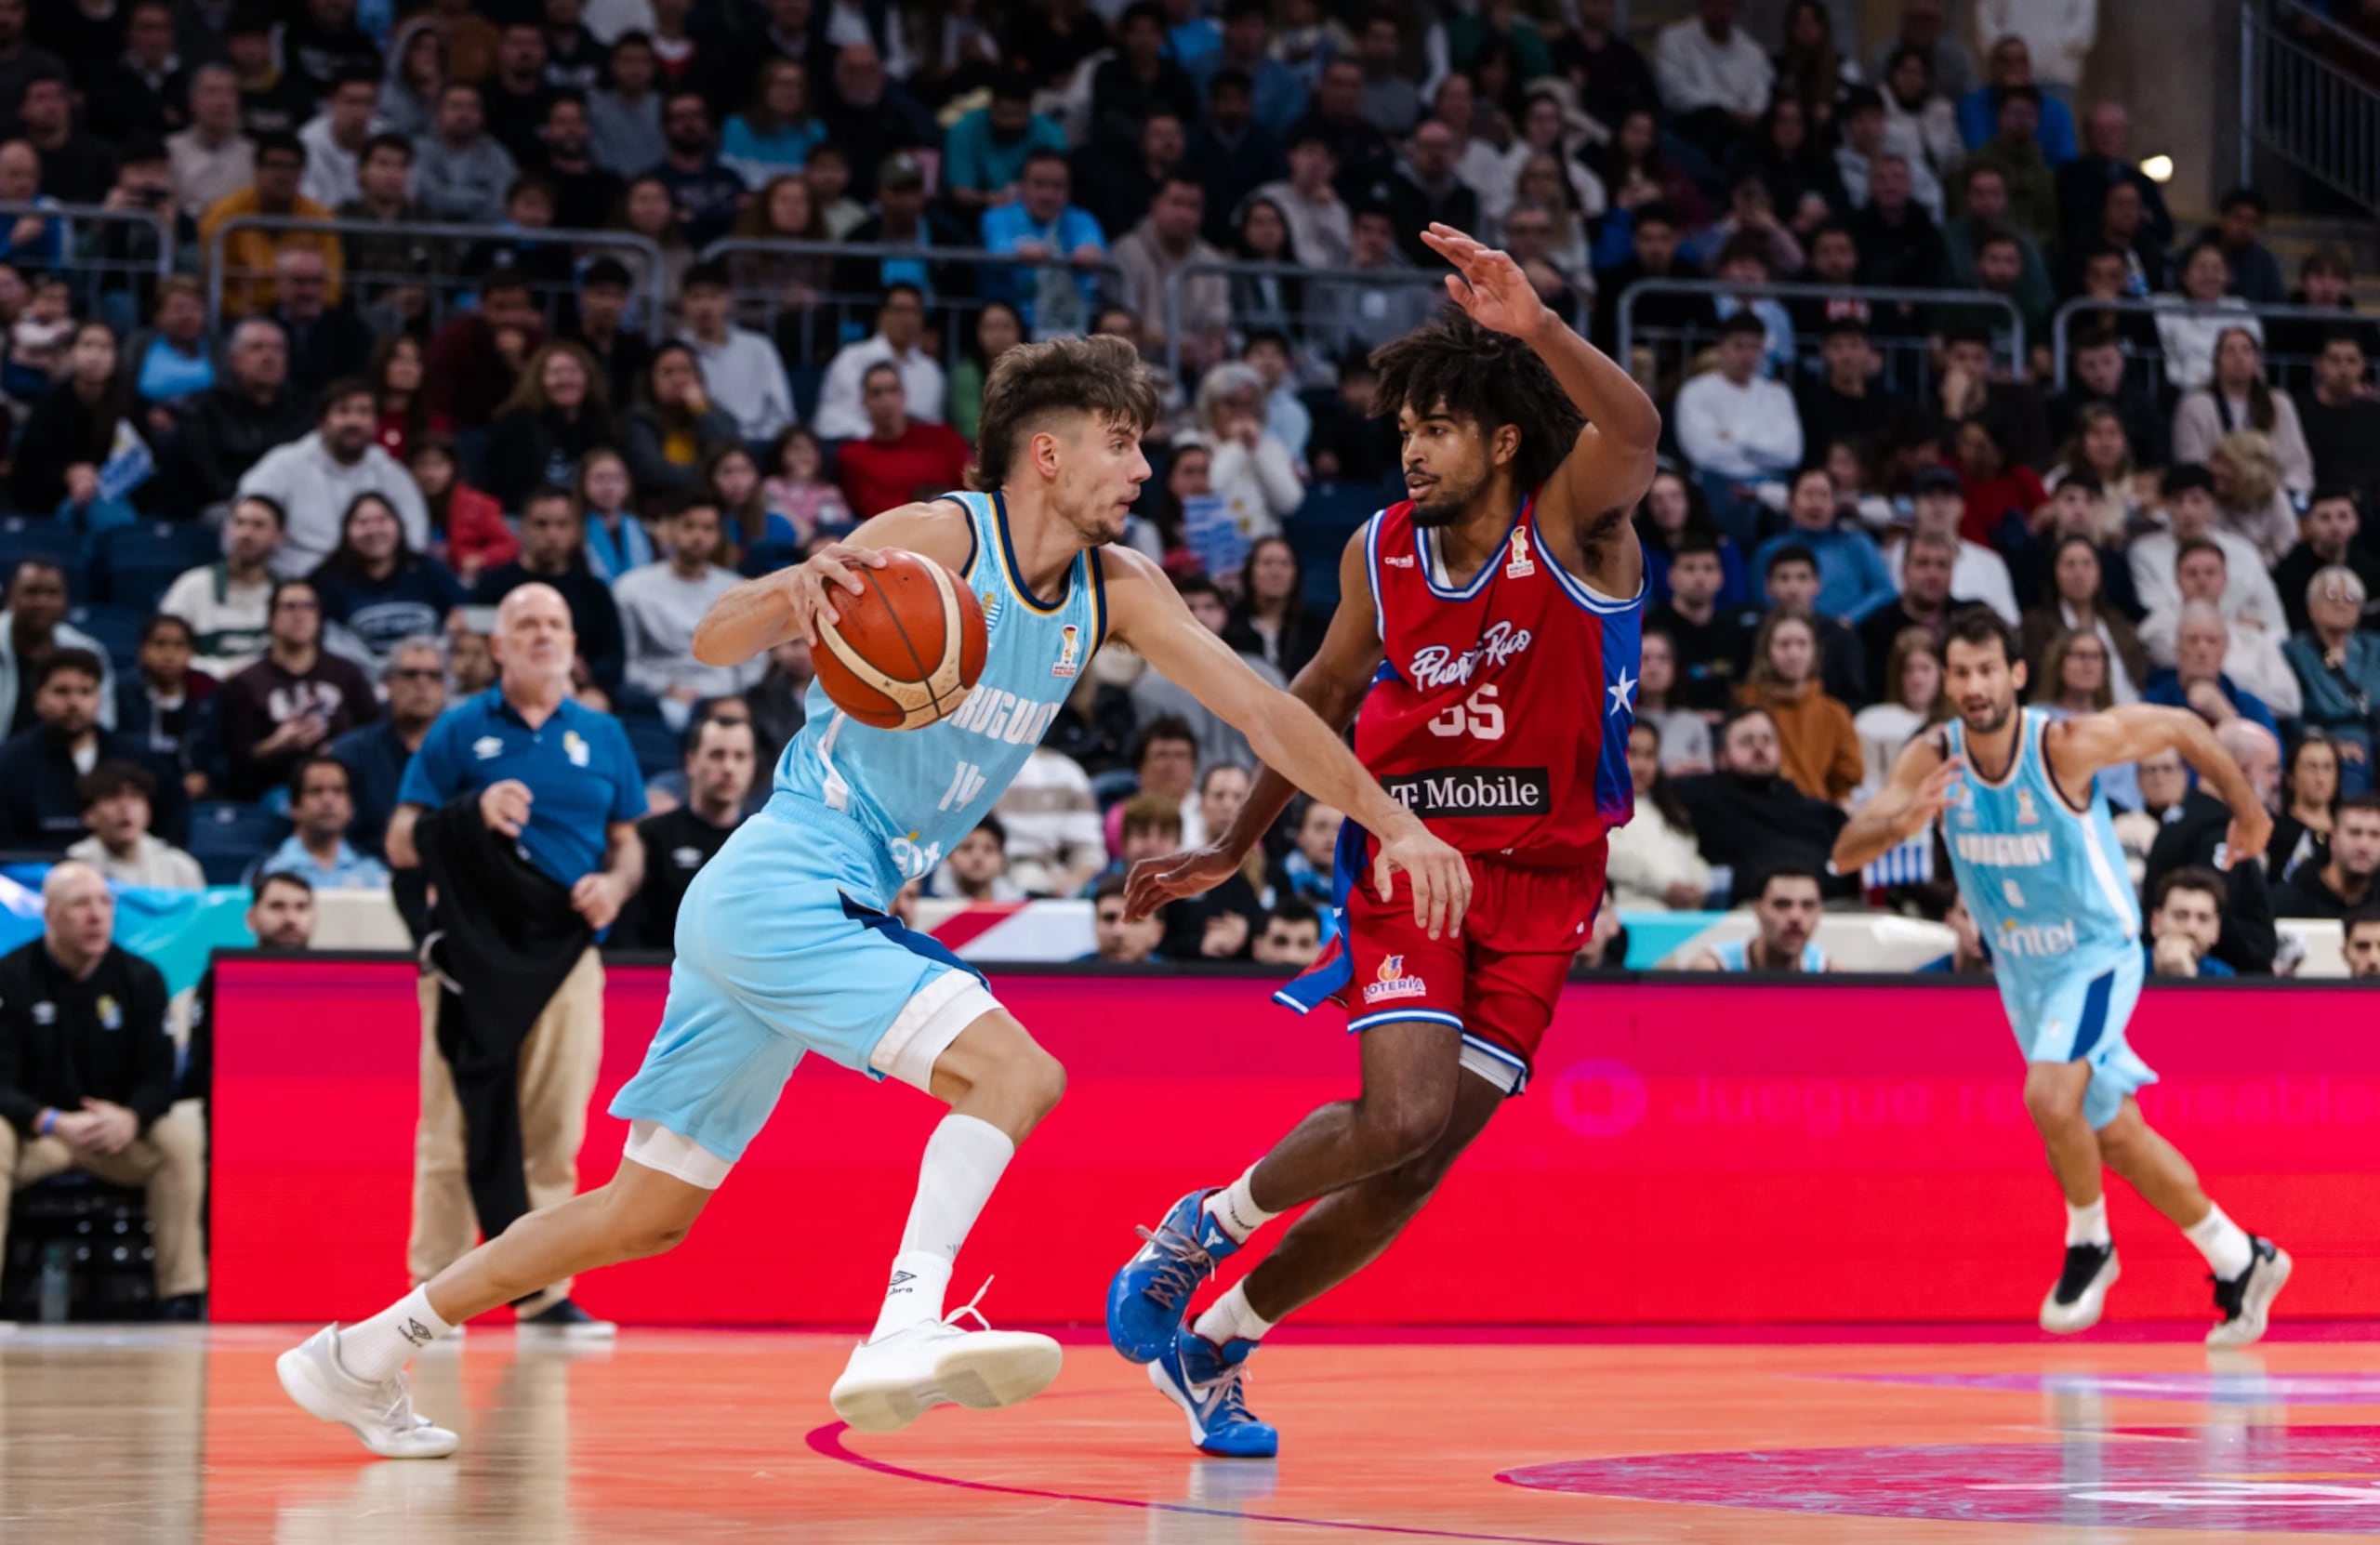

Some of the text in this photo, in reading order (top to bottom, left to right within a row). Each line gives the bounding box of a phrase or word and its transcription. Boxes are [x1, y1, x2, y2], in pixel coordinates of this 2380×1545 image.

[1482, 620, 1532, 667] Rico
[941, 683, 1062, 745] RUGUA
[937, 760, 987, 813] 14
[1423, 775, 1540, 810] Mobile
[1958, 1073, 2380, 1125] rensable
